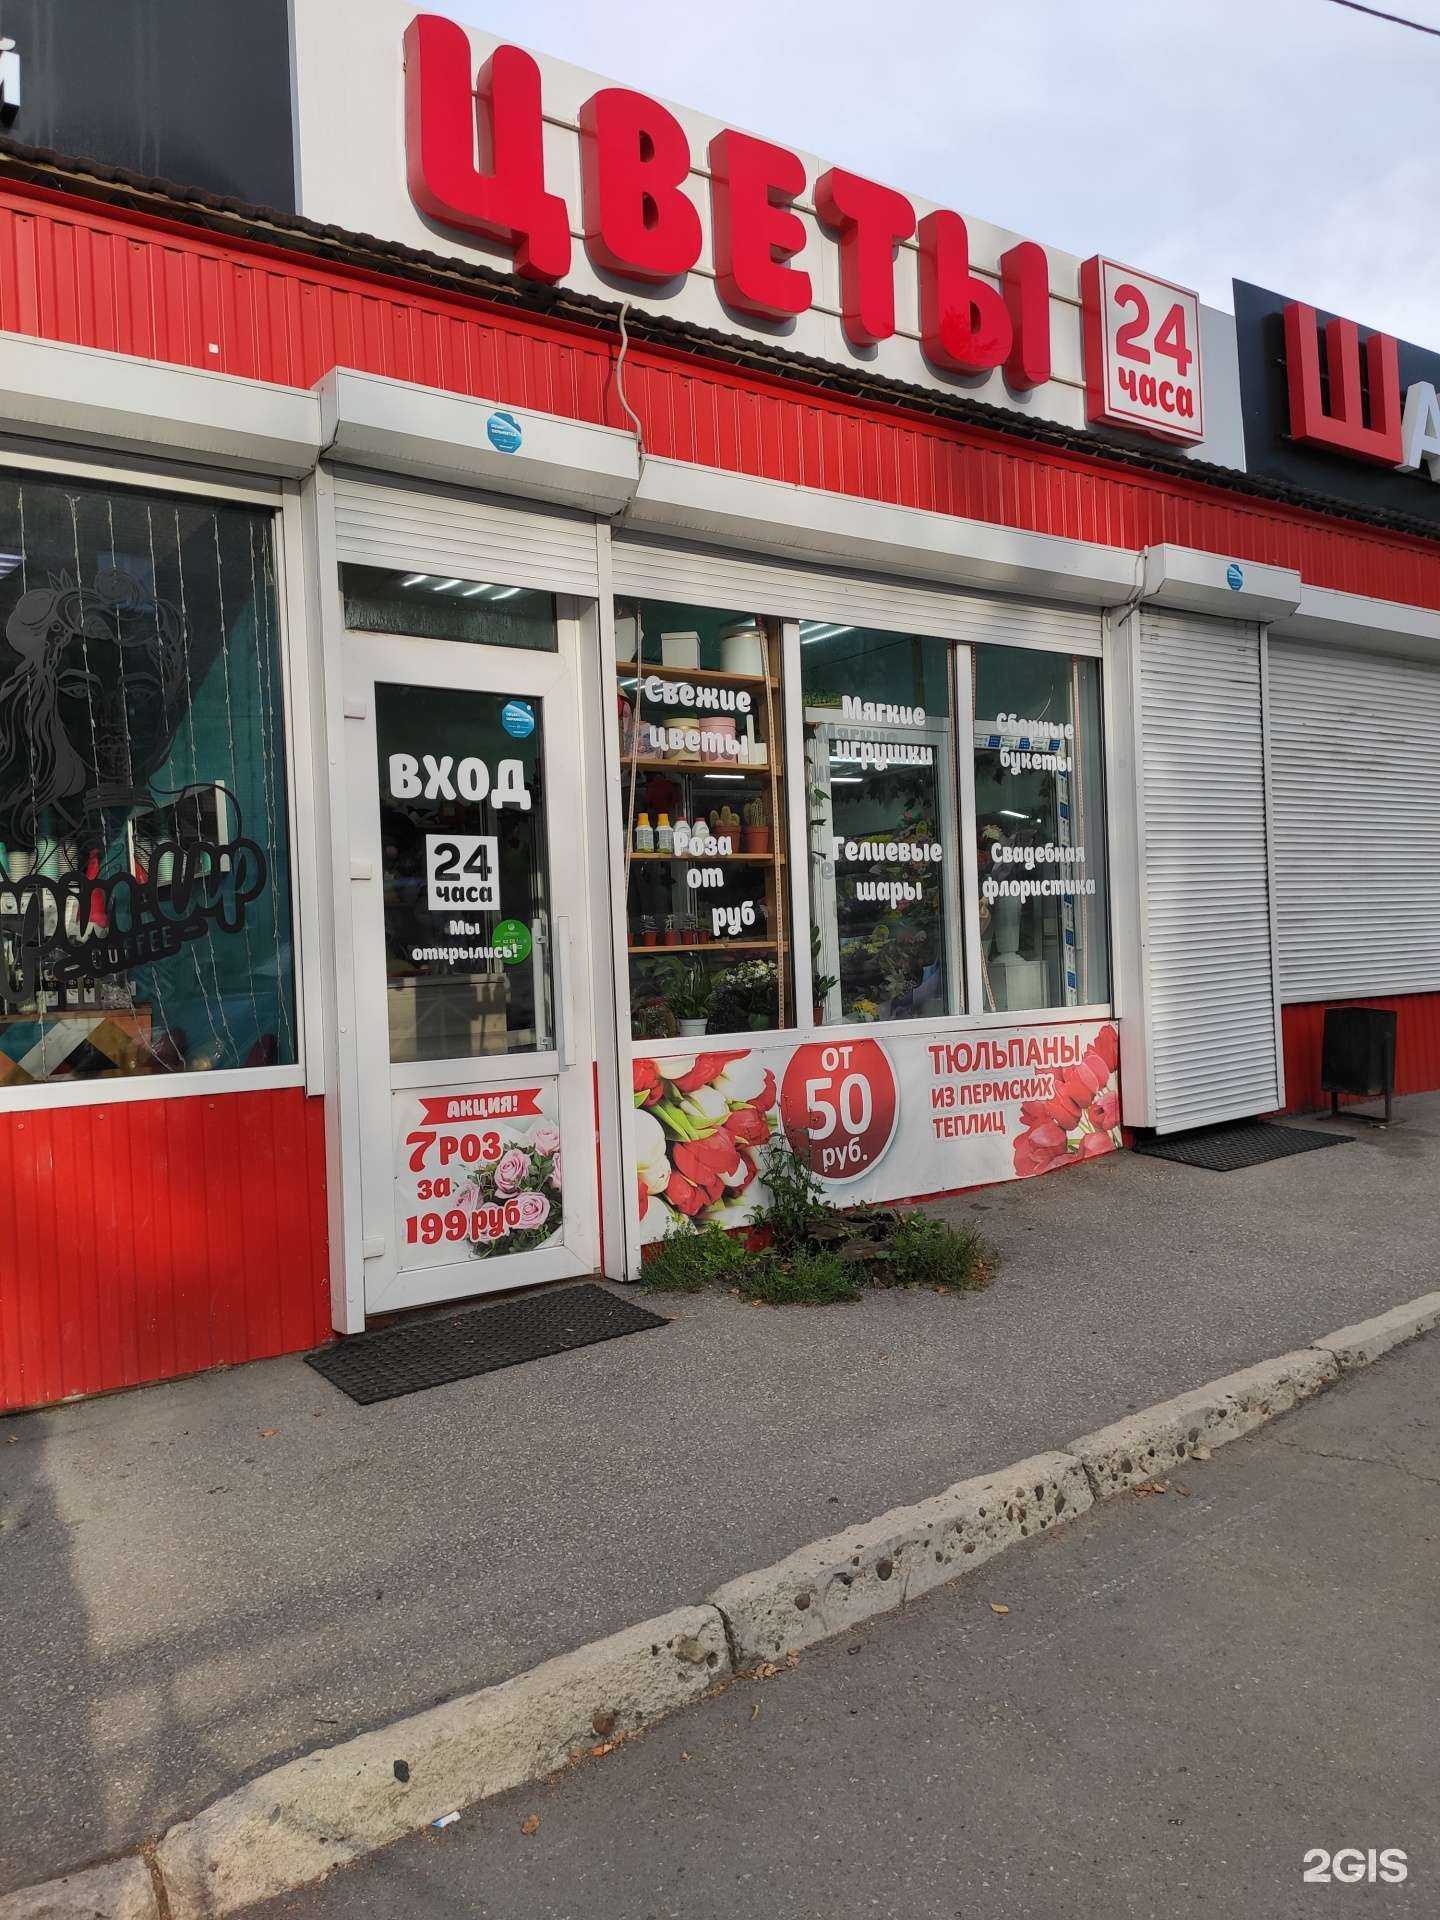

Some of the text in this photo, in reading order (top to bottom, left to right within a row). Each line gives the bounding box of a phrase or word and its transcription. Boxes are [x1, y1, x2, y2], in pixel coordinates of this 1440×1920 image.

[404, 14, 1051, 391] ЦВЕТЫ
[1113, 283, 1193, 377] 24
[1117, 365, 1194, 419] часа
[1284, 301, 1440, 484] ША
[644, 675, 752, 713] Свежие
[841, 695, 926, 726] Мягкие
[649, 726, 748, 756] цветы
[996, 713, 1075, 741] Сборные
[836, 740, 934, 771] игрушки
[1000, 747, 1072, 775] букеты
[388, 753, 532, 811] ВХОД
[673, 831, 733, 857] Роза
[831, 836, 943, 863] Гелиевые
[991, 842, 1086, 870] Свадебная
[434, 842, 493, 882] 24
[686, 866, 725, 889] от
[982, 876, 1096, 904] флористика
[435, 885, 493, 903] часа
[856, 881, 923, 910] шары
[449, 920, 481, 936] Мы
[711, 900, 756, 937] руб
[411, 943, 519, 966] открылись!
[822, 1045, 854, 1071] ОТ
[928, 1034, 1081, 1076] ТЮЛЬПАНЫ
[931, 1075, 1055, 1107] ИЗ ПЕРМСКИХ
[447, 1095, 519, 1118] АКЦИЯ!
[804, 1073, 873, 1141] 50
[932, 1111, 1006, 1139] ТЕПЛИЦ
[405, 1131, 502, 1173] 7 РОЗ
[821, 1136, 868, 1172] руб.
[417, 1178, 451, 1200] за
[406, 1200, 521, 1244] 199 руб
